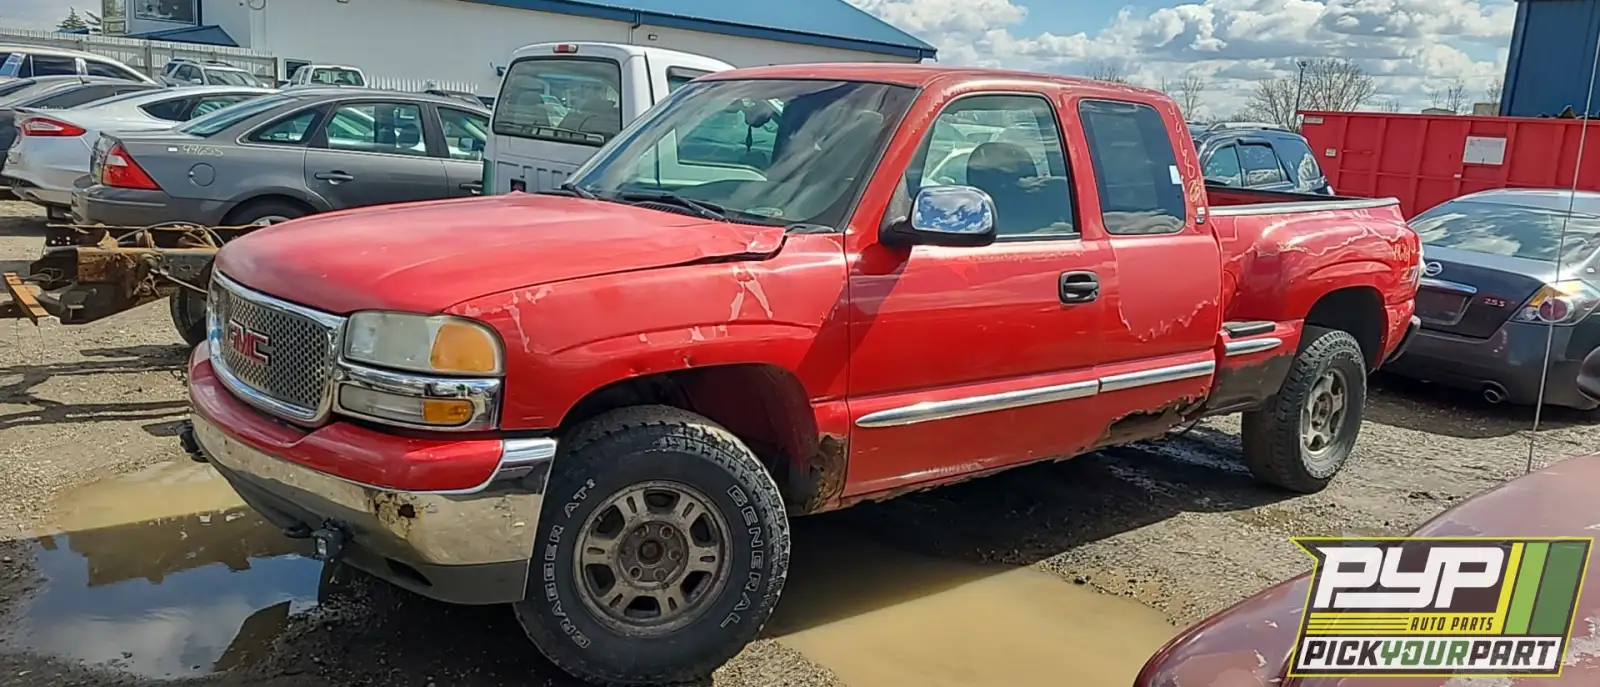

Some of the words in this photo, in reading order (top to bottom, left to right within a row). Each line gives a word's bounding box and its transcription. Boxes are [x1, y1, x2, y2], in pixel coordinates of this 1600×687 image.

[226, 319, 270, 365] GMC
[543, 524, 591, 649] GRABBER
[720, 484, 764, 629] GENERAL
